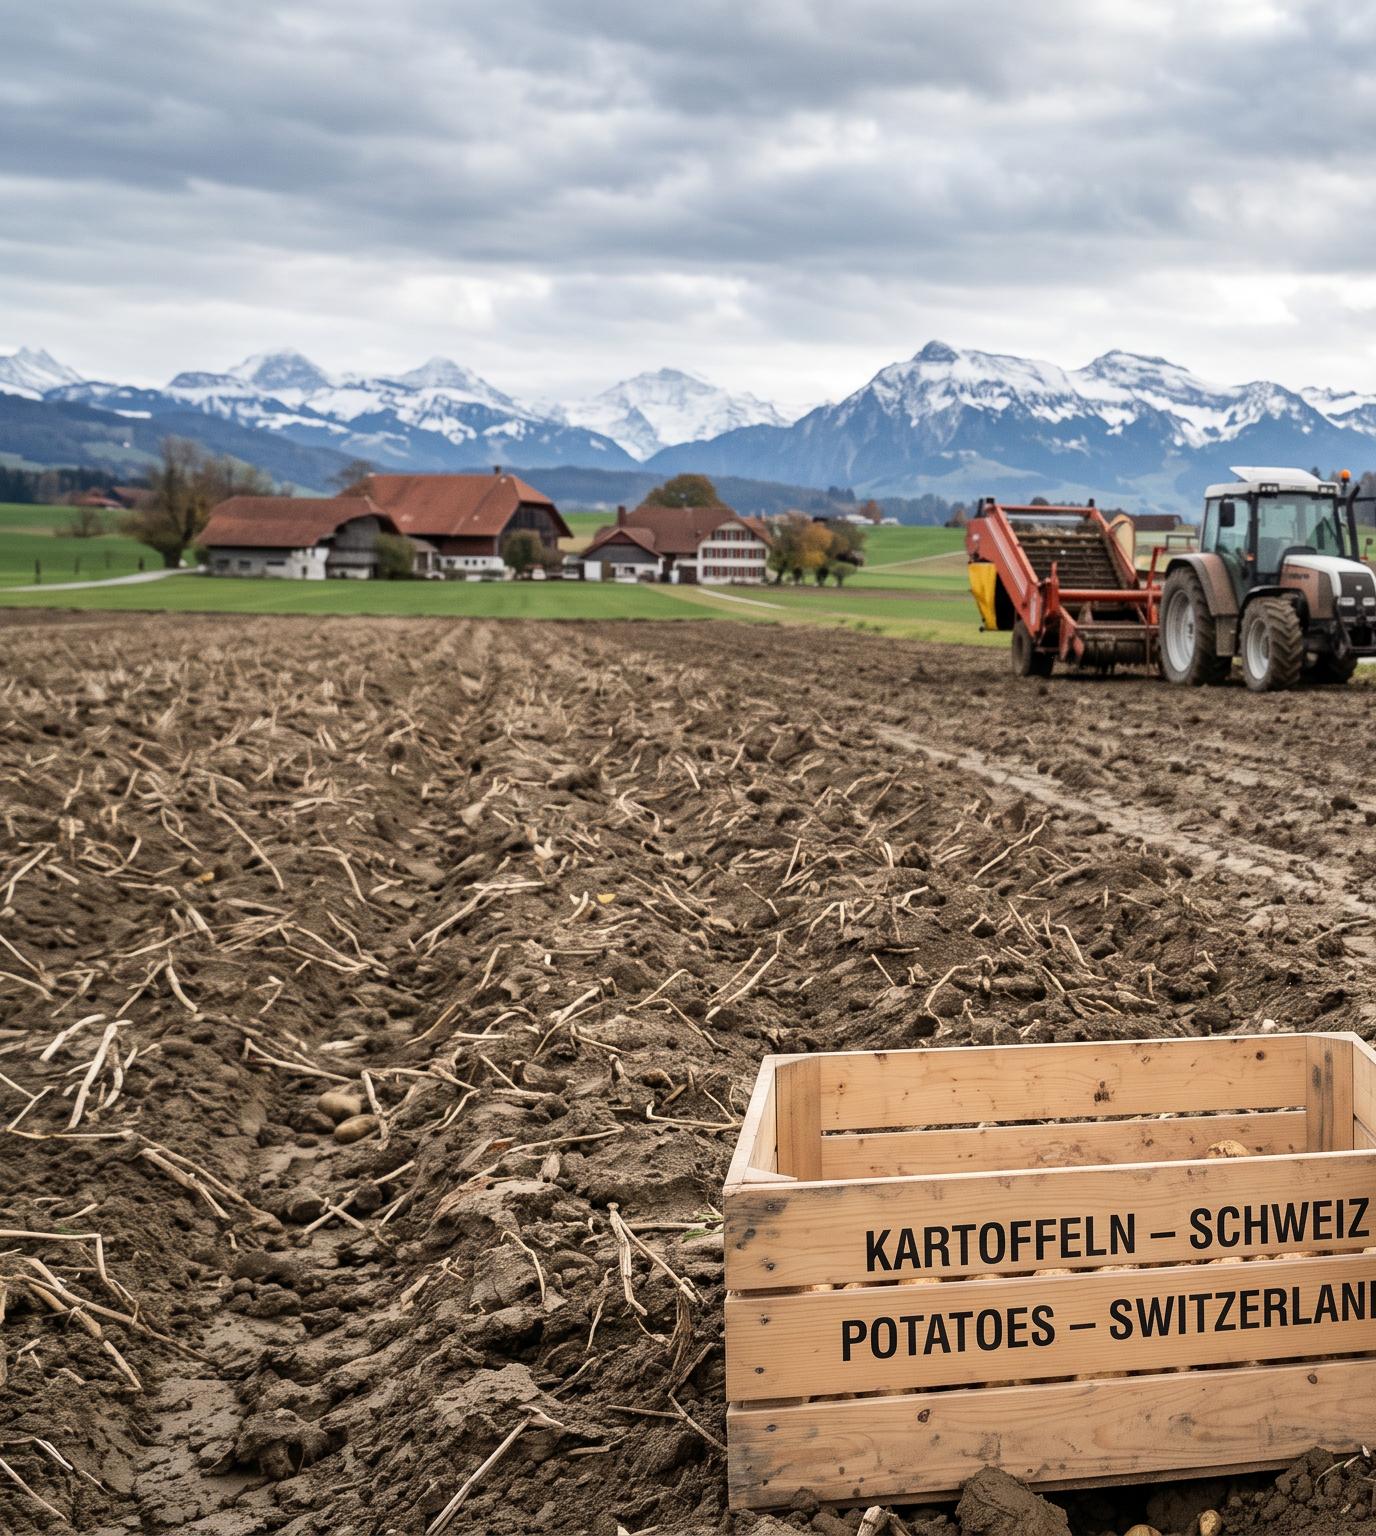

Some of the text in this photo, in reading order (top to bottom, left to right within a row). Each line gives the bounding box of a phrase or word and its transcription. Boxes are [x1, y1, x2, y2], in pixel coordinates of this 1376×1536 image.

[865, 1212, 1136, 1273] KARTOFFELN
[1189, 1196, 1371, 1250] SCHWEIZ
[841, 1304, 1056, 1362] POTATOES
